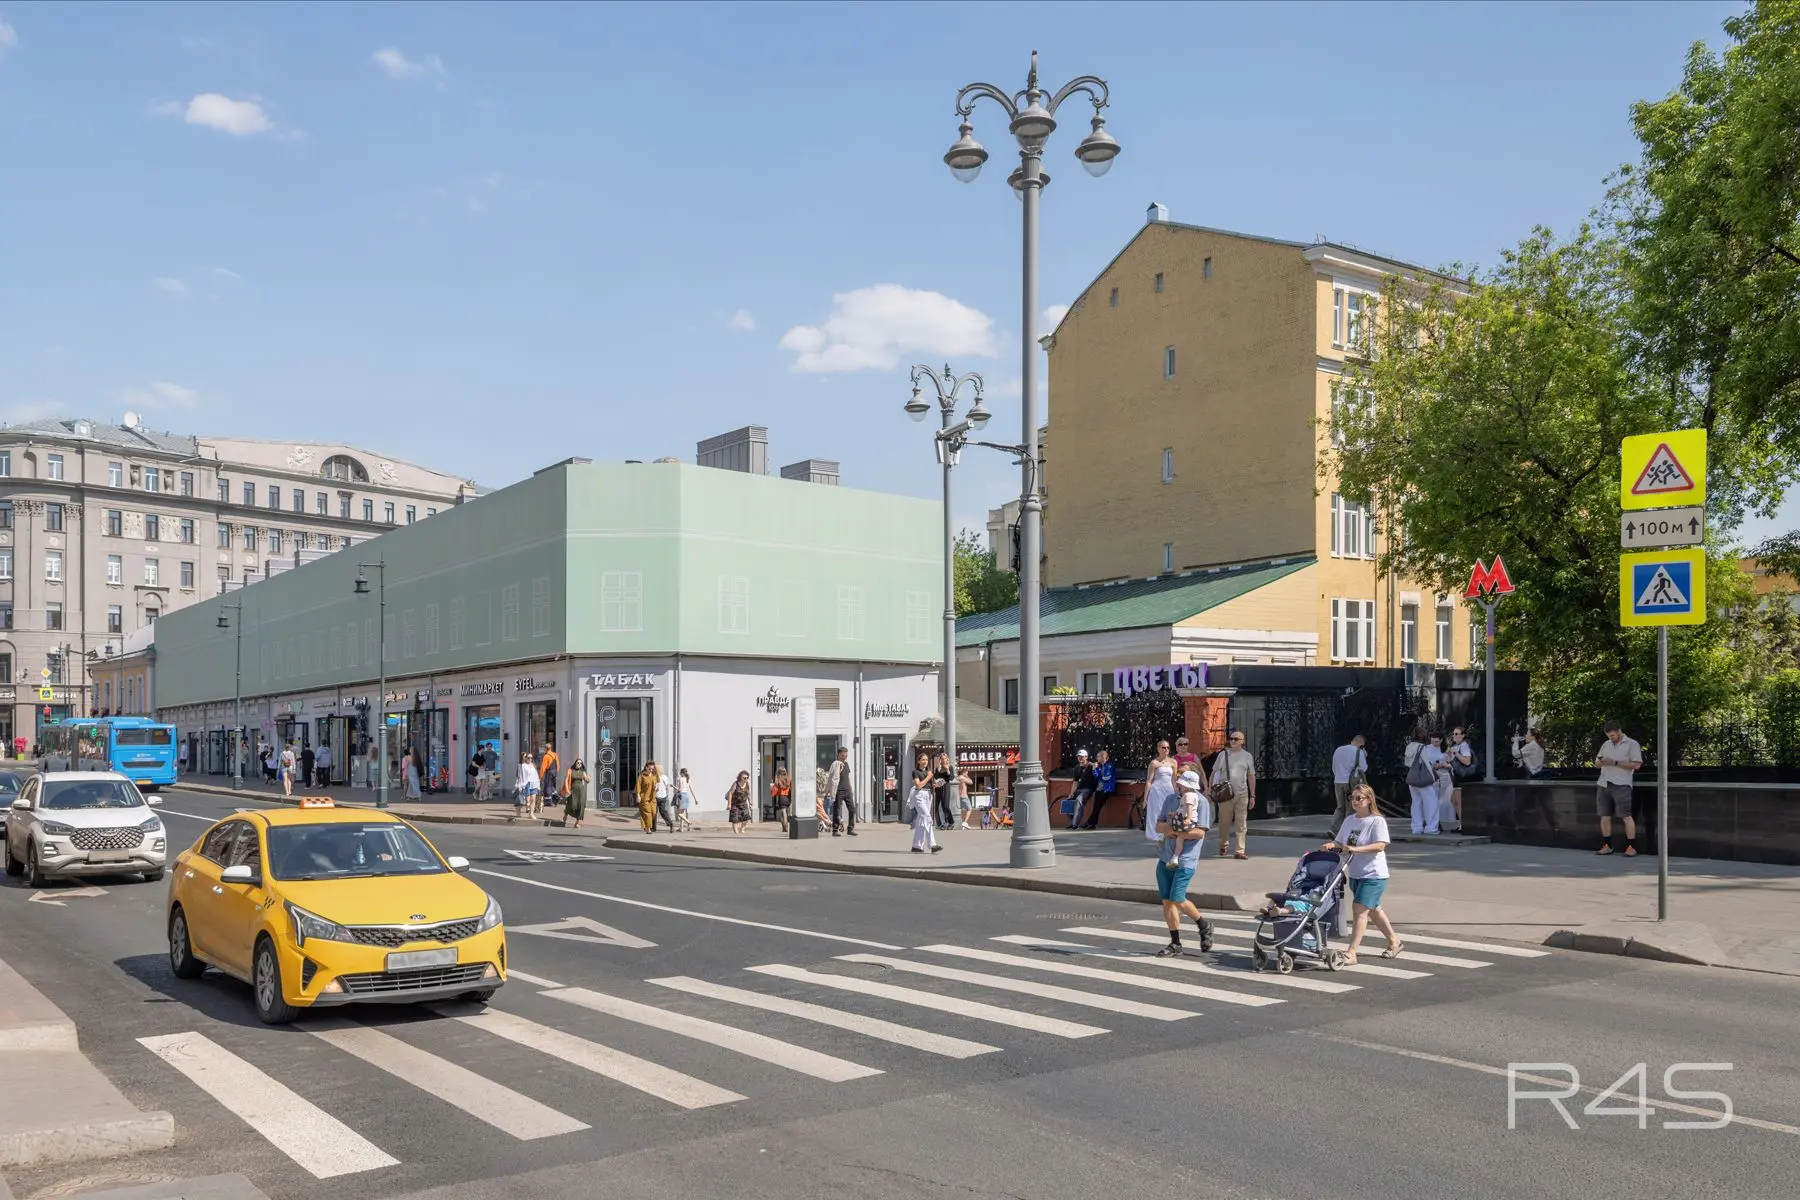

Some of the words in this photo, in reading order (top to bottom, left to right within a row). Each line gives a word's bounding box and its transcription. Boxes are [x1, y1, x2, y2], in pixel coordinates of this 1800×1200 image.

[514, 678, 535, 690] EYFEL
[591, 673, 655, 686] ТАБАК
[1113, 662, 1208, 698] ЦВЕТЫ
[460, 682, 504, 697] МИНИМАРКЕТ
[759, 696, 791, 705] ПРАВДА
[960, 752, 1002, 761] ДОНЕР
